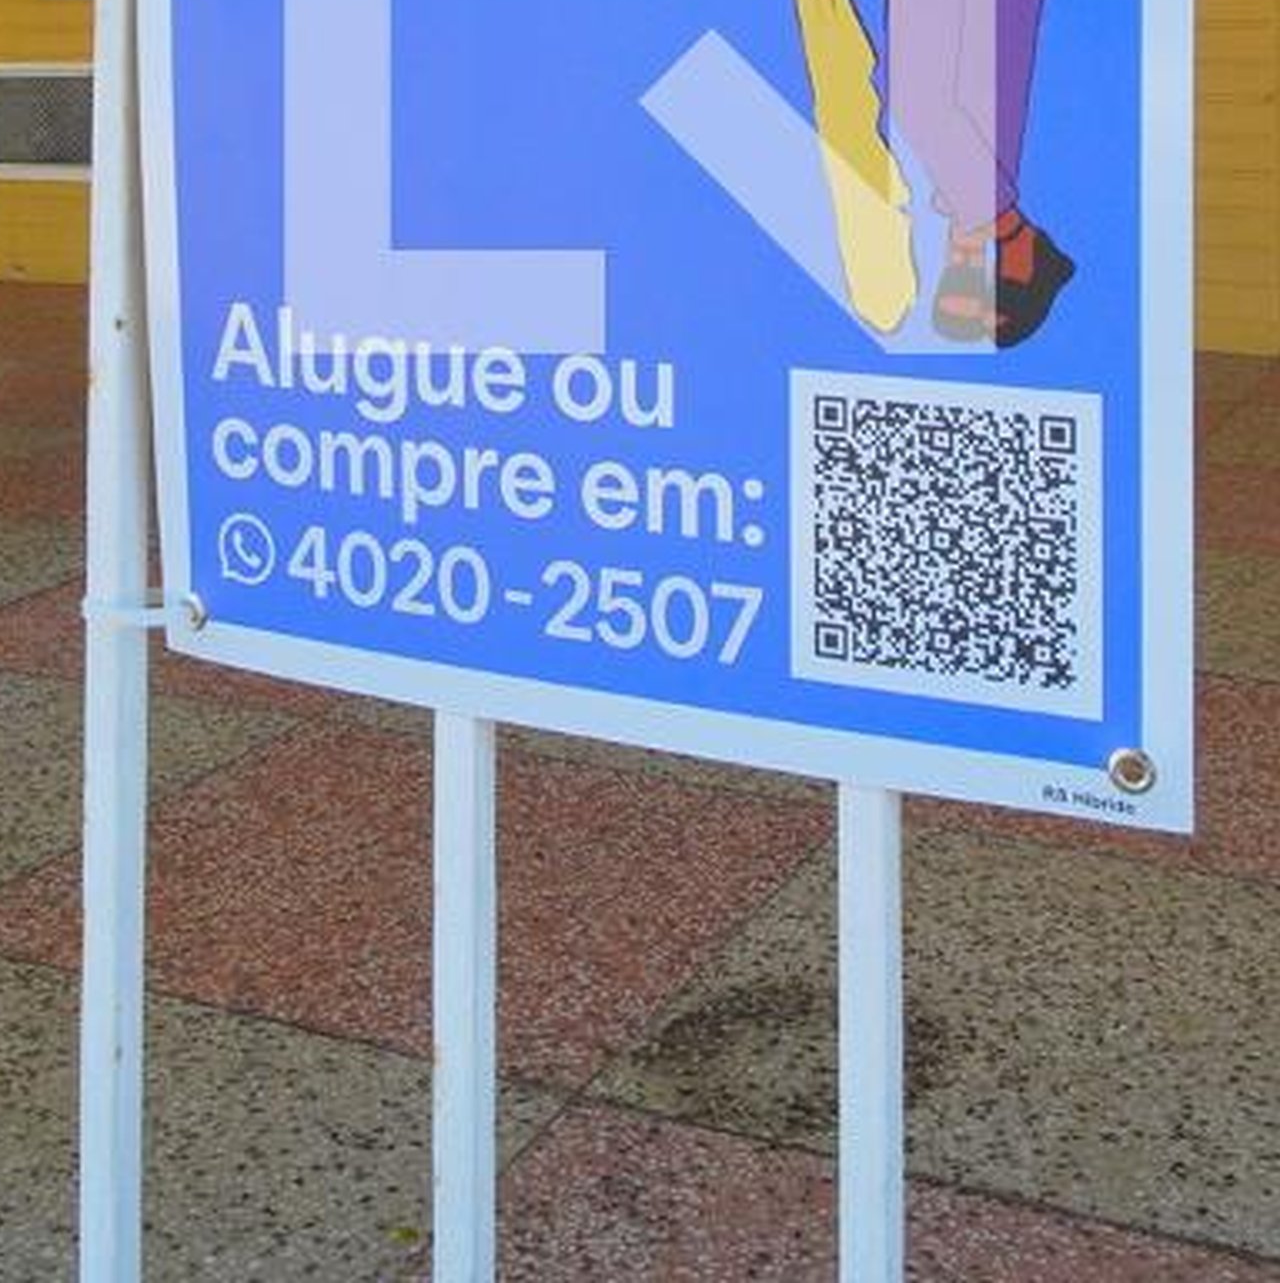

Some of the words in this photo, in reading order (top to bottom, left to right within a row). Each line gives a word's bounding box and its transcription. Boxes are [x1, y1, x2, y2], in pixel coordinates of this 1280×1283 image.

[211, 302, 526, 423] Alugue
[552, 354, 676, 428] ou
[212, 417, 554, 523] compre
[580, 459, 766, 547] em:
